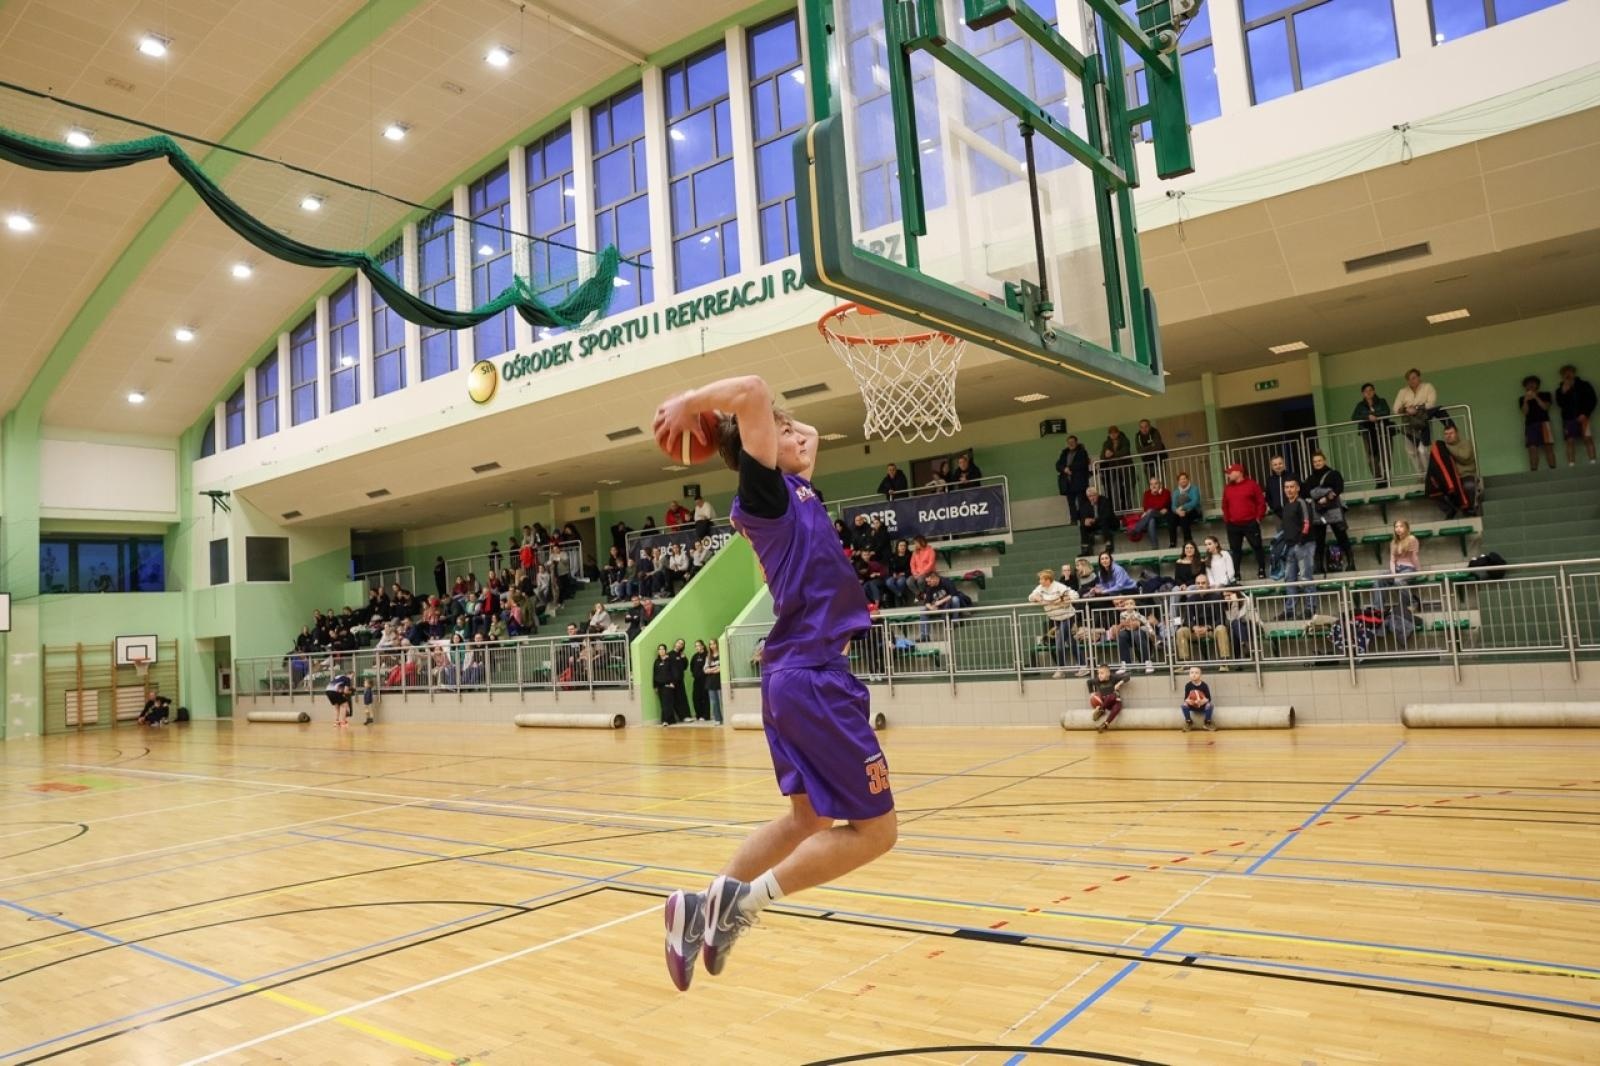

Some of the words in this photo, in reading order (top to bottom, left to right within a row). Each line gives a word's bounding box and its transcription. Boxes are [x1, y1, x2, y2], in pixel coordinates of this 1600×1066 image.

[502, 341, 574, 381] OŚRODEK
[578, 315, 648, 358] SPORTU
[653, 311, 660, 335] I
[665, 274, 775, 331] REKREACJI
[918, 501, 989, 523] RACIBÓRZ
